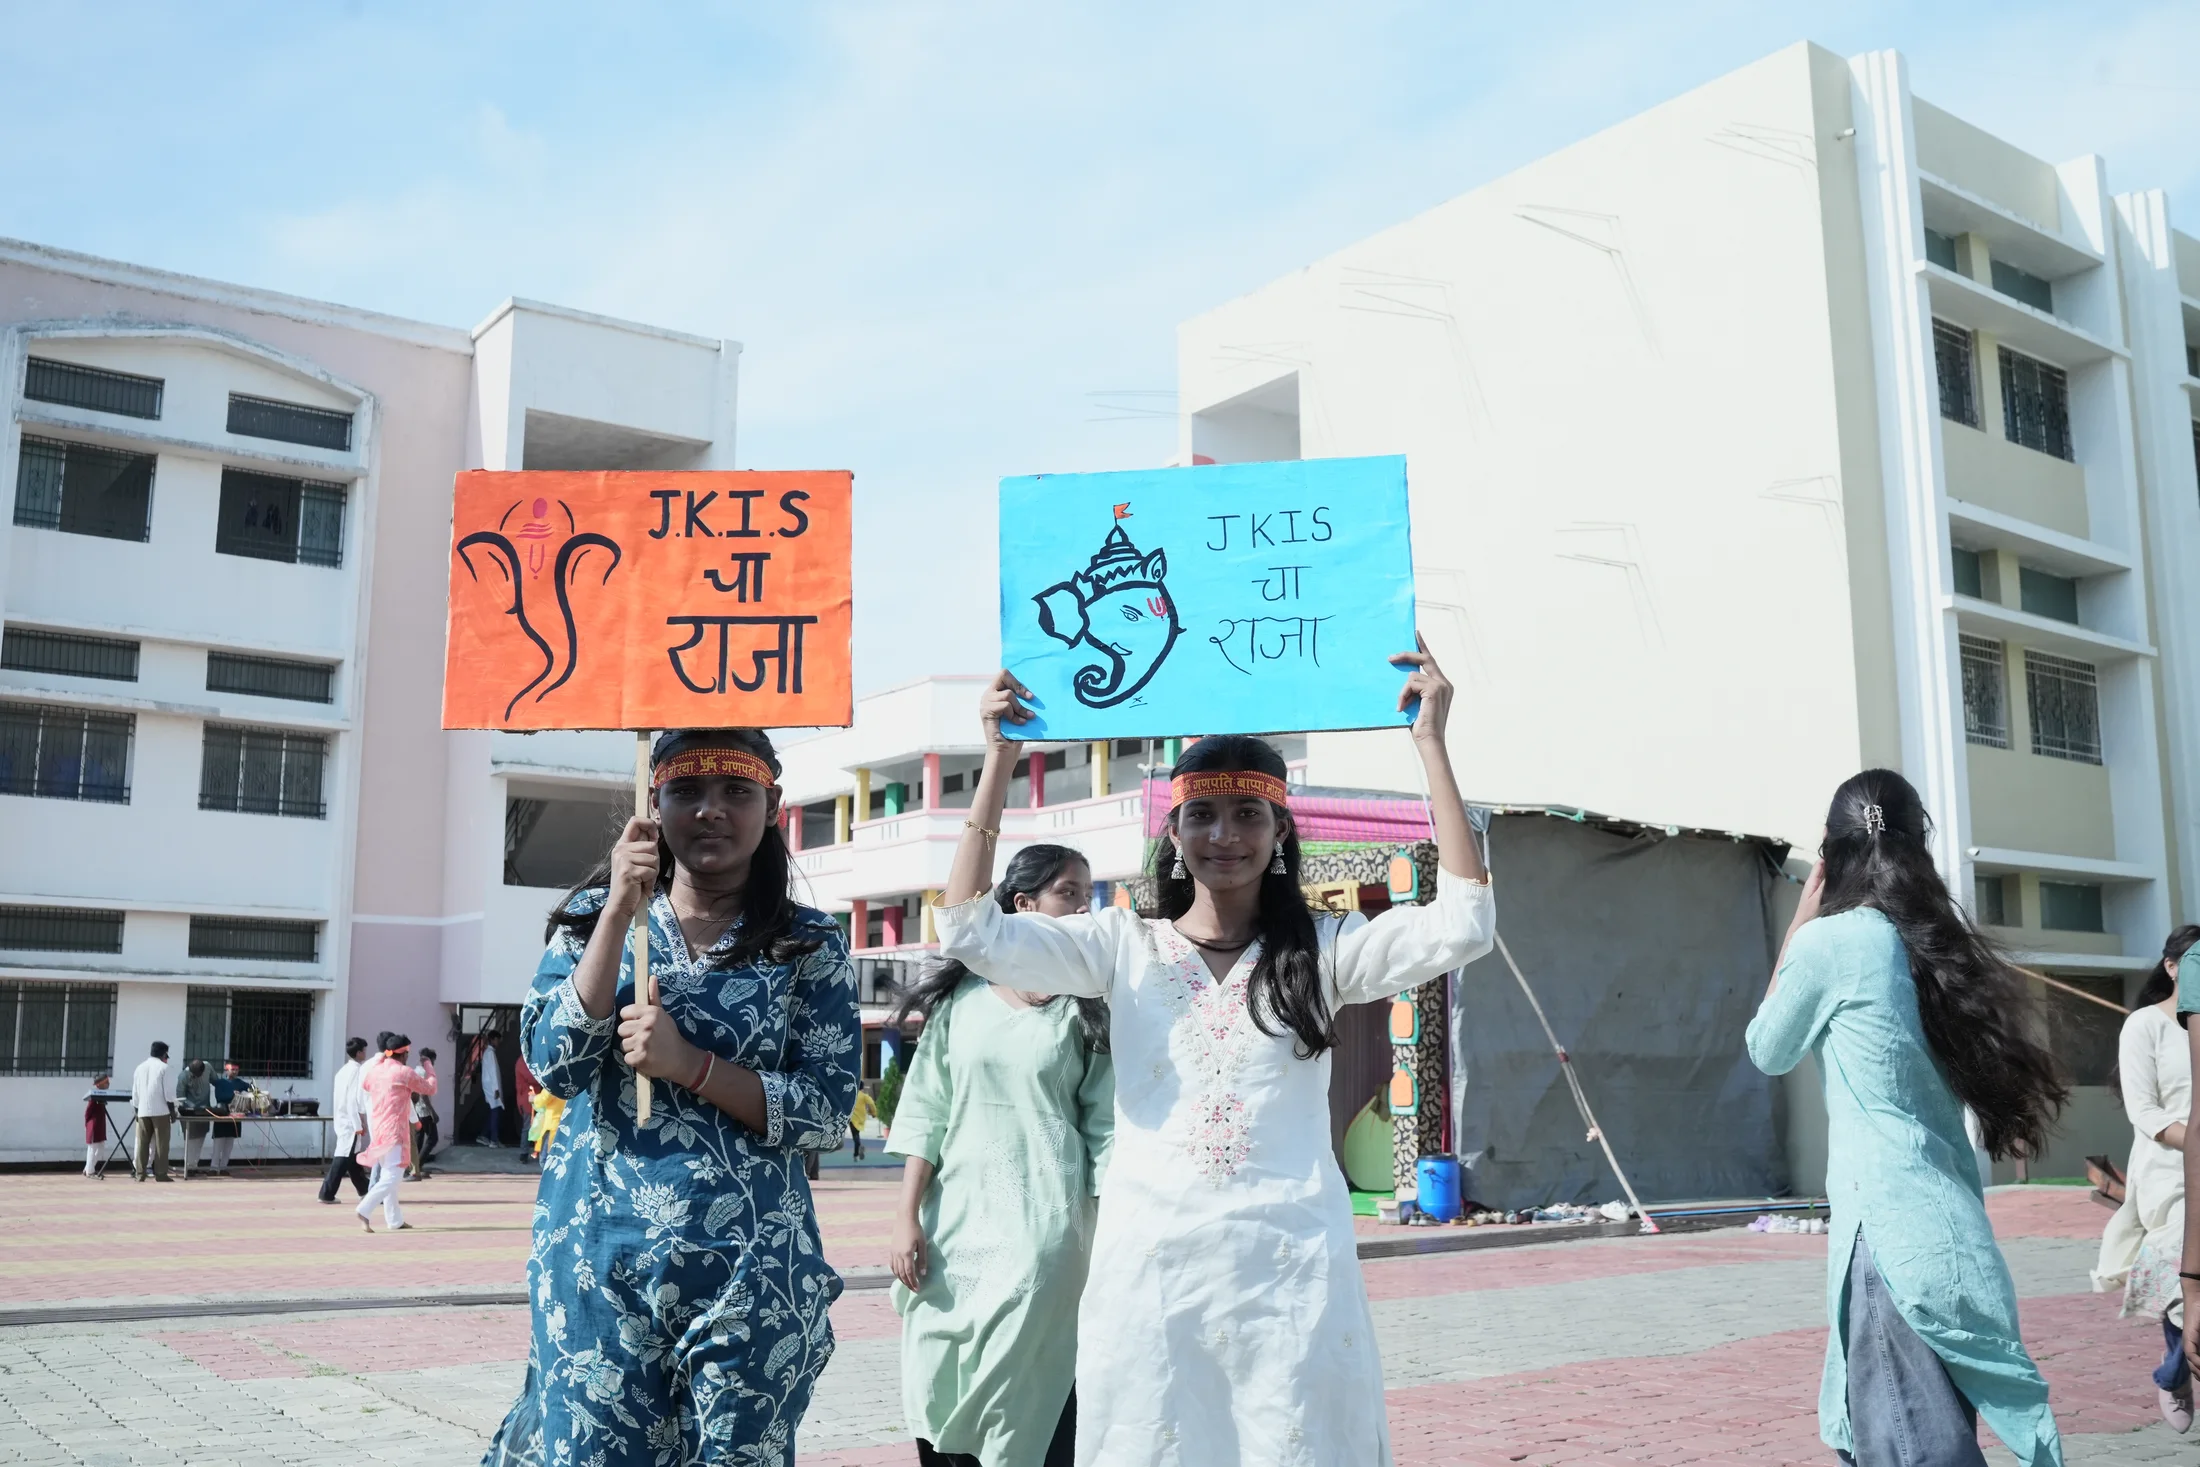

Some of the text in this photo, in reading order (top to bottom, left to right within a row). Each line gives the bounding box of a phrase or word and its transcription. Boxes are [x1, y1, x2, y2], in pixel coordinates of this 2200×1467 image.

[648, 489, 811, 539] J.K.I.S
[703, 552, 772, 603] चा
[1251, 565, 1313, 602] चा
[666, 615, 818, 694] राजा
[1209, 614, 1337, 676] राजा
[722, 761, 757, 778] गणपती
[1193, 773, 1233, 790] गणपति
[1237, 777, 1265, 793] बाप्पा
